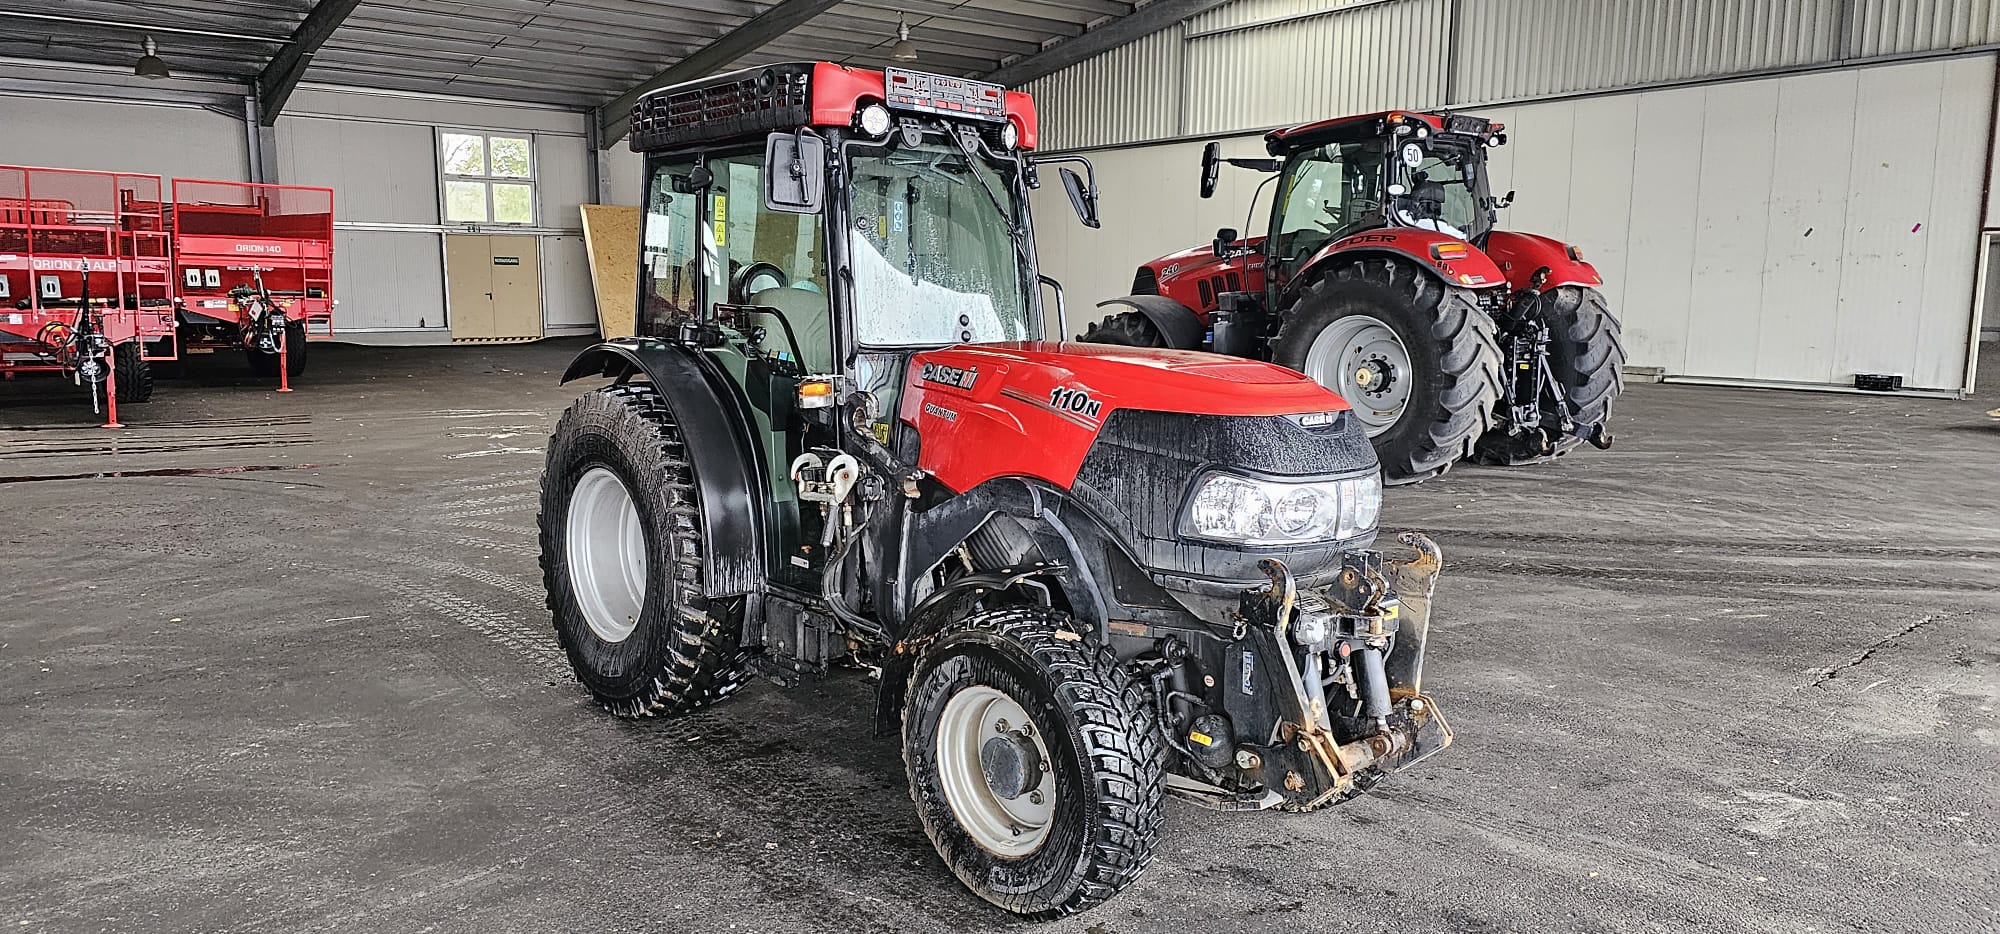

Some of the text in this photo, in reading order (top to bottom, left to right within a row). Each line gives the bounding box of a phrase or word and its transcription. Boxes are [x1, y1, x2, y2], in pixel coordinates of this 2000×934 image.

[1407, 149, 1419, 162] 50
[235, 244, 281, 254] ORION 140
[1334, 234, 1397, 250] EDER
[33, 259, 73, 270] ORION
[921, 363, 959, 385] CASE
[924, 403, 958, 422] QUANTUM
